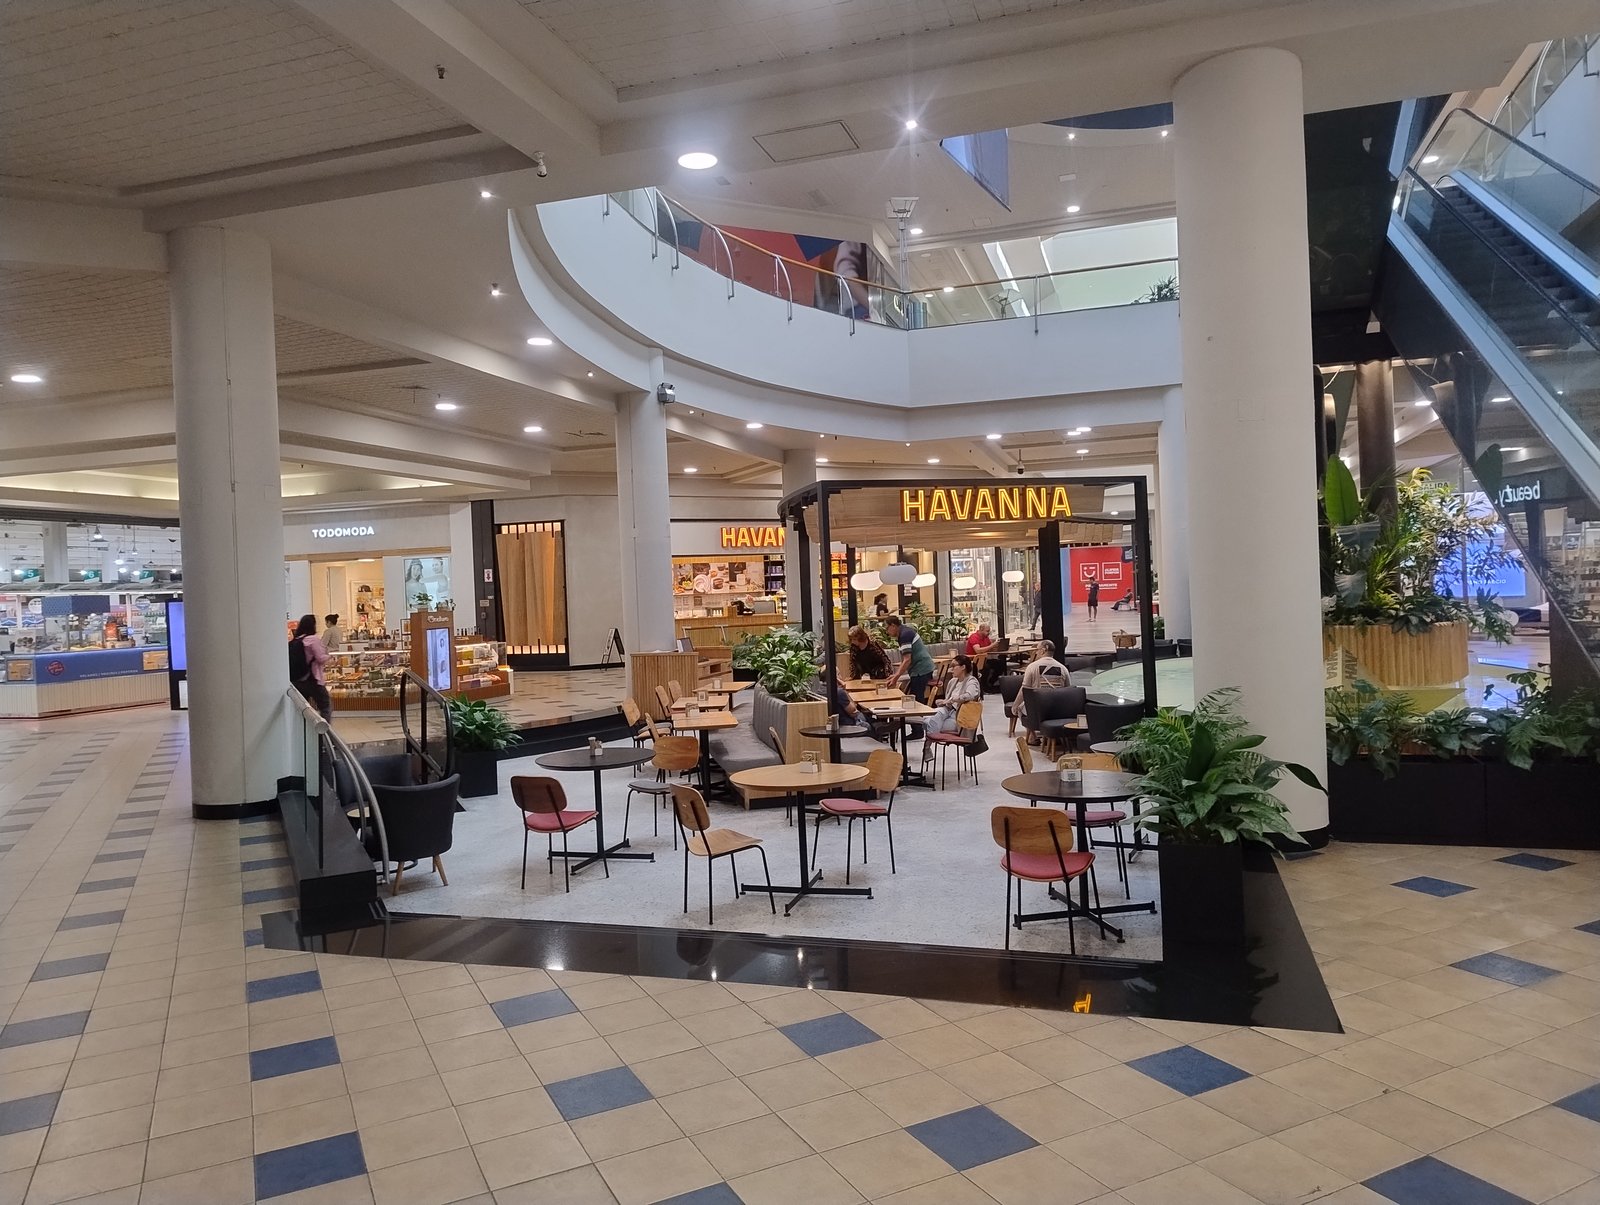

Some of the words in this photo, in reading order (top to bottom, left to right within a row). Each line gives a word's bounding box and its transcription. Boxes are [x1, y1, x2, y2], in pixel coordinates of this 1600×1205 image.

[901, 486, 1072, 523] HAVANNA
[312, 526, 375, 538] TODOMODA
[27, 569, 34, 578] 5
[88, 570, 95, 579] 6
[143, 570, 149, 578] 7
